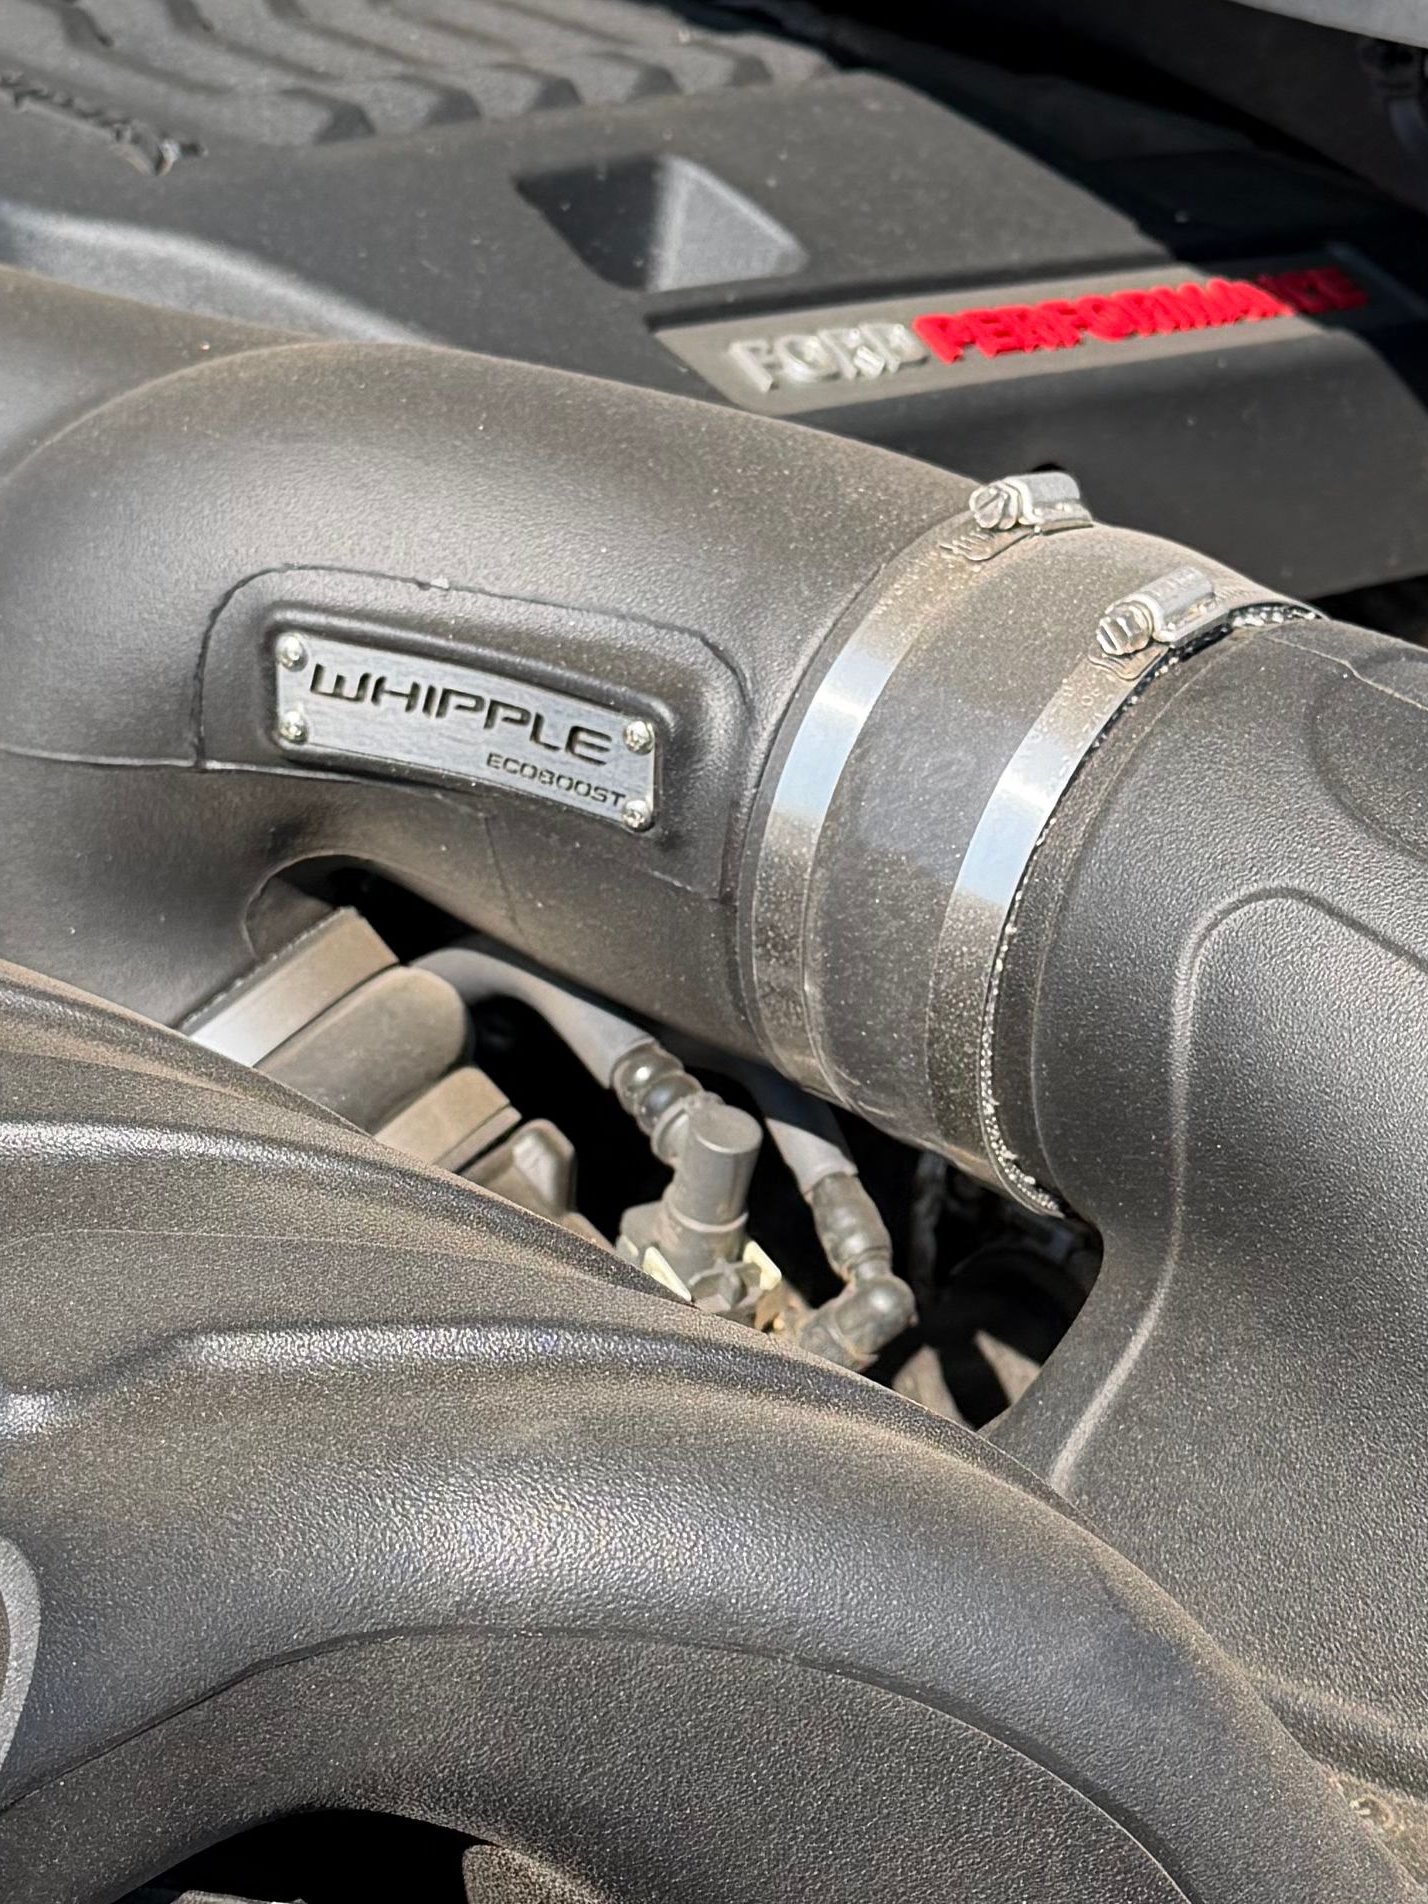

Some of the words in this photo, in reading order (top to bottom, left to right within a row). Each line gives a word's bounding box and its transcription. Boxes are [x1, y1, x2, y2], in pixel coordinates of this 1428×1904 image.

[728, 322, 929, 393] FORD
[309, 663, 614, 767] WHIPPLE
[486, 751, 627, 807] ECOBOOST
